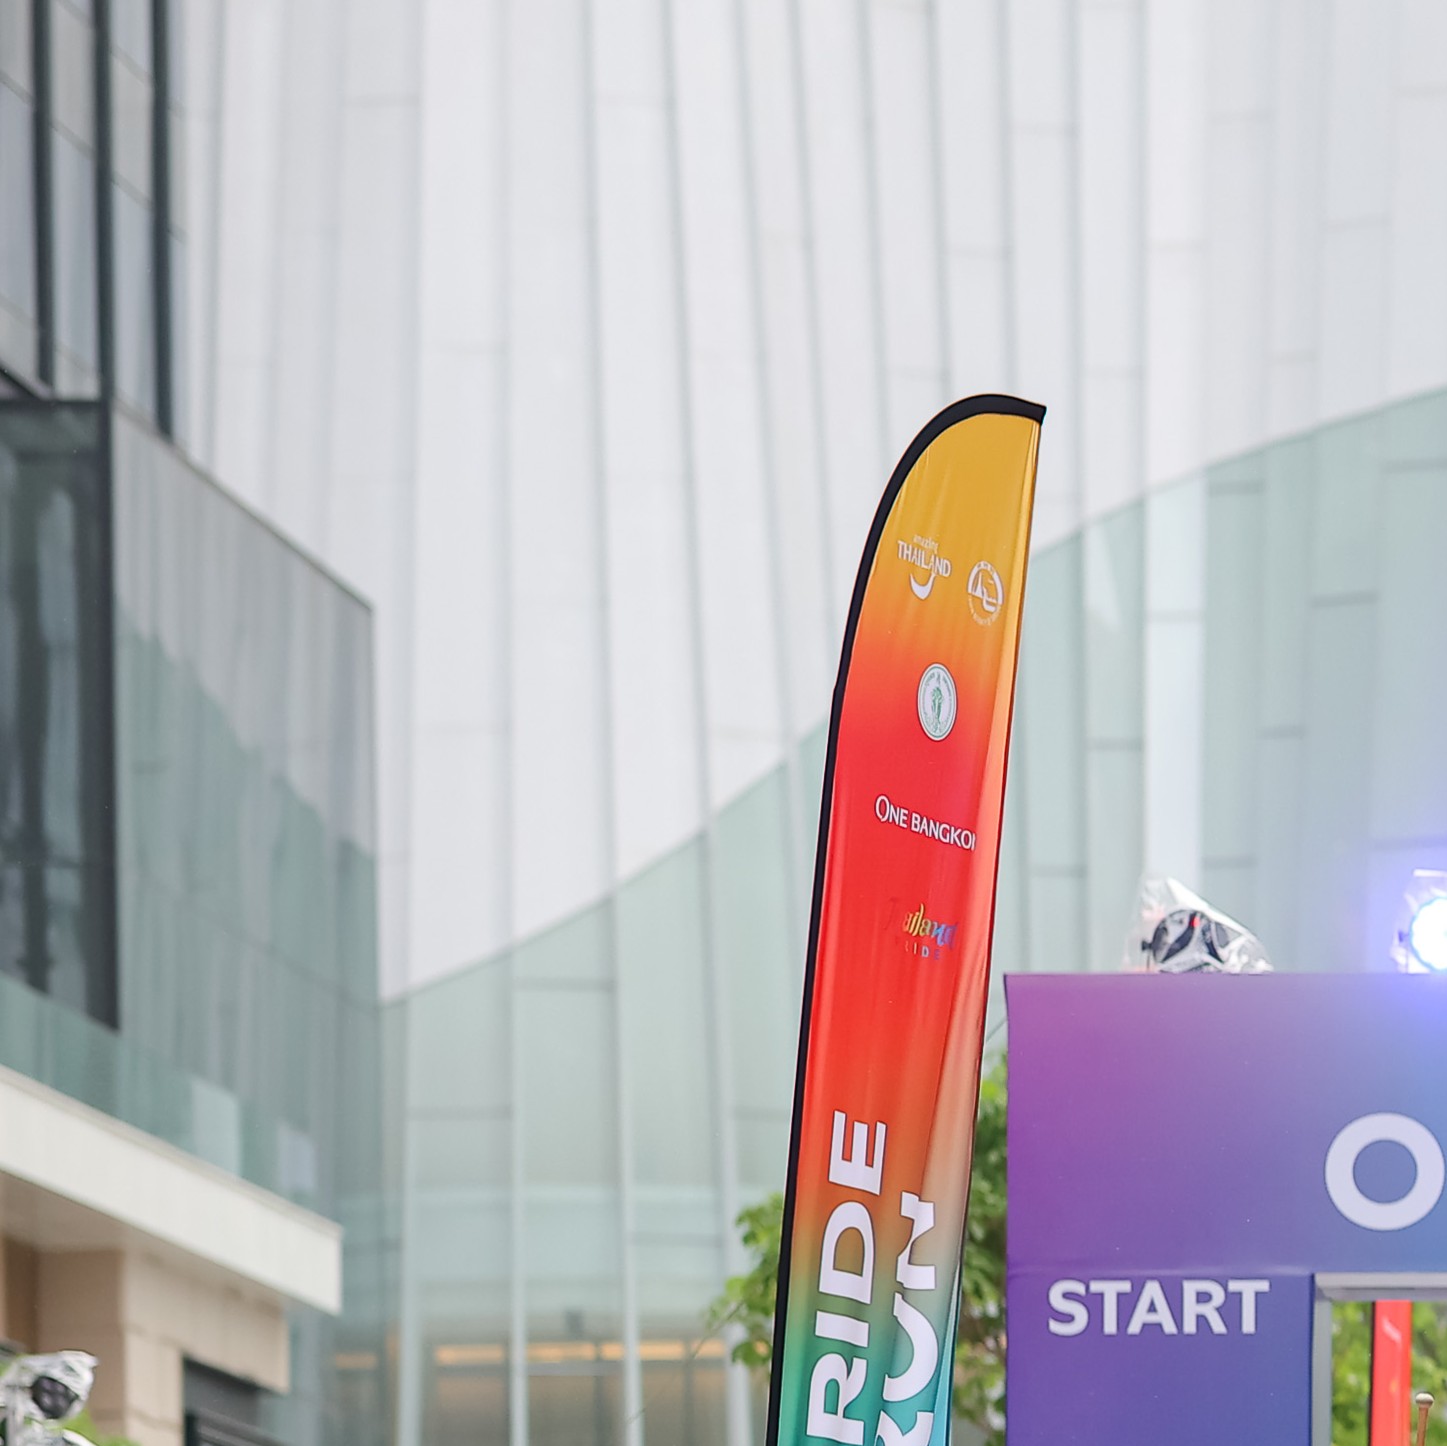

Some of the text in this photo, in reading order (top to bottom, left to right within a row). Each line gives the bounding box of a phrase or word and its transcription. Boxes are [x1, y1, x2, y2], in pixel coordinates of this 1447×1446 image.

[897, 540, 952, 578] THAILAND
[875, 795, 908, 828] ONE
[1047, 1279, 1270, 1337] START
